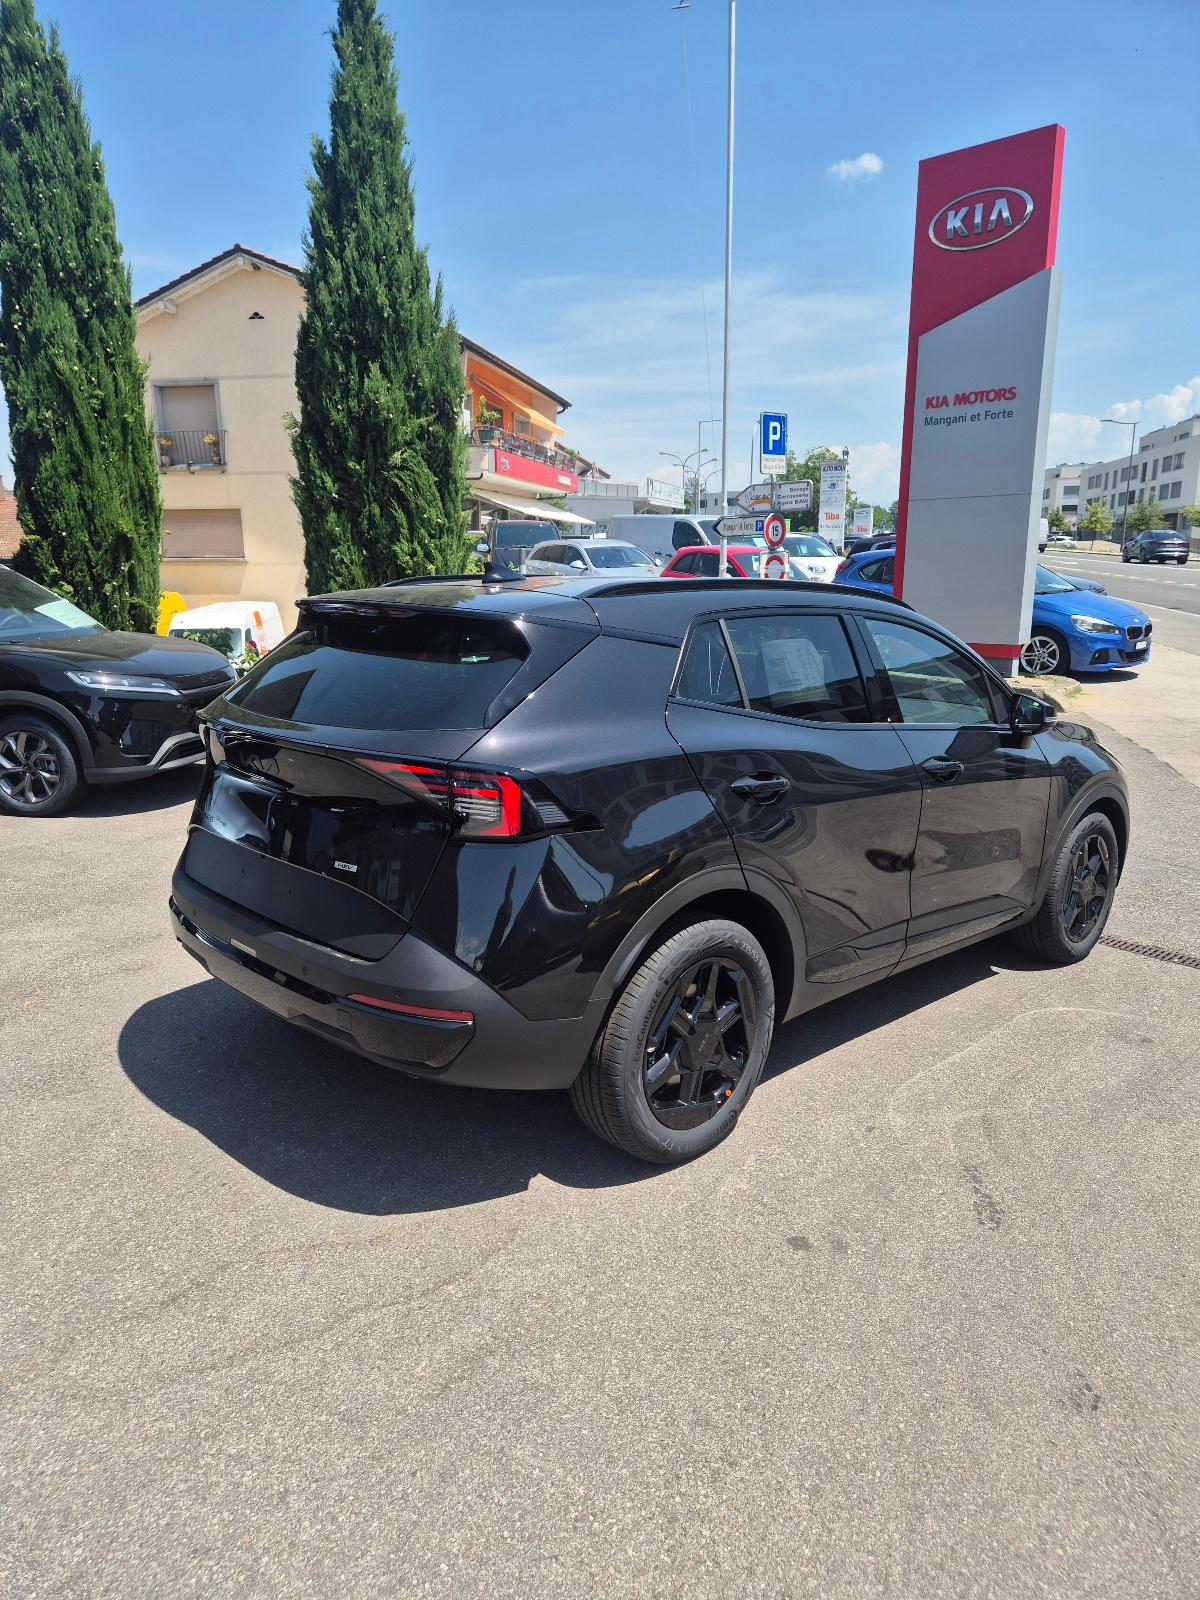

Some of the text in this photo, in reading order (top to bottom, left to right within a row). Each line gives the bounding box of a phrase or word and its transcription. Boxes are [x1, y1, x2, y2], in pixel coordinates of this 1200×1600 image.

[945, 197, 1013, 241] KIA
[925, 386, 1017, 410] KIA MOTORS
[924, 409, 1014, 427] Mangani et Forte
[768, 421, 781, 451] P
[824, 512, 841, 521] Tiba
[772, 525, 780, 537] 15
[633, 998, 658, 1063] EcoContact
